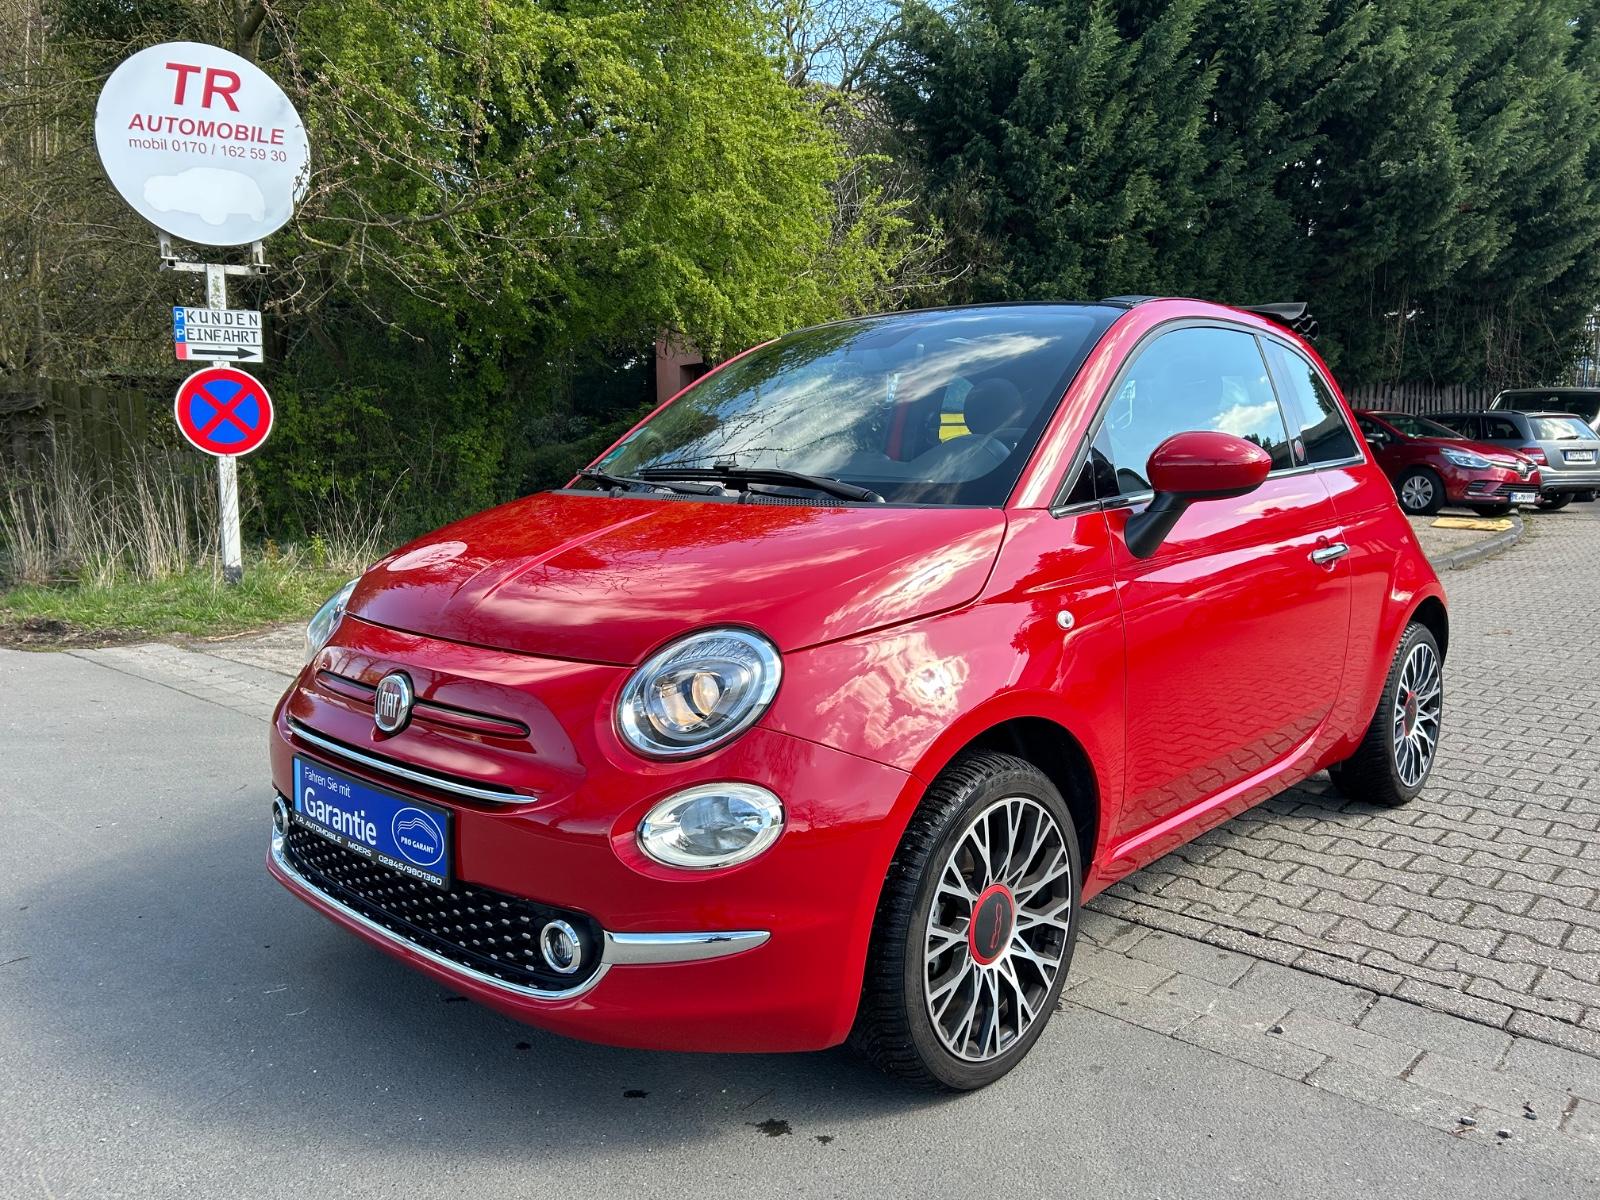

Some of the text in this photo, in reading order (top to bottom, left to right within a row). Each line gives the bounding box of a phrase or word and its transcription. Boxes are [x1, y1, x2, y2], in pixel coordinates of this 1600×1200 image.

[166, 62, 241, 112] TR
[128, 113, 285, 145] AUTOMOBILE
[128, 137, 167, 150] mobil
[172, 139, 207, 155] 0170
[222, 144, 246, 158] 162
[250, 147, 266, 160] 59
[270, 150, 287, 163] 30
[175, 310, 258, 326] P KUNDEN
[176, 328, 258, 343] P EINFAHRT
[381, 691, 400, 718] FIAT
[304, 766, 351, 798] Fahren Sie mit
[304, 787, 377, 846] Garantie
[305, 820, 342, 844] AUTOMOBILE
[347, 841, 372, 857] MOERS
[378, 855, 442, 885] 02845/9801380
[400, 836, 435, 854] PRO GARANT
